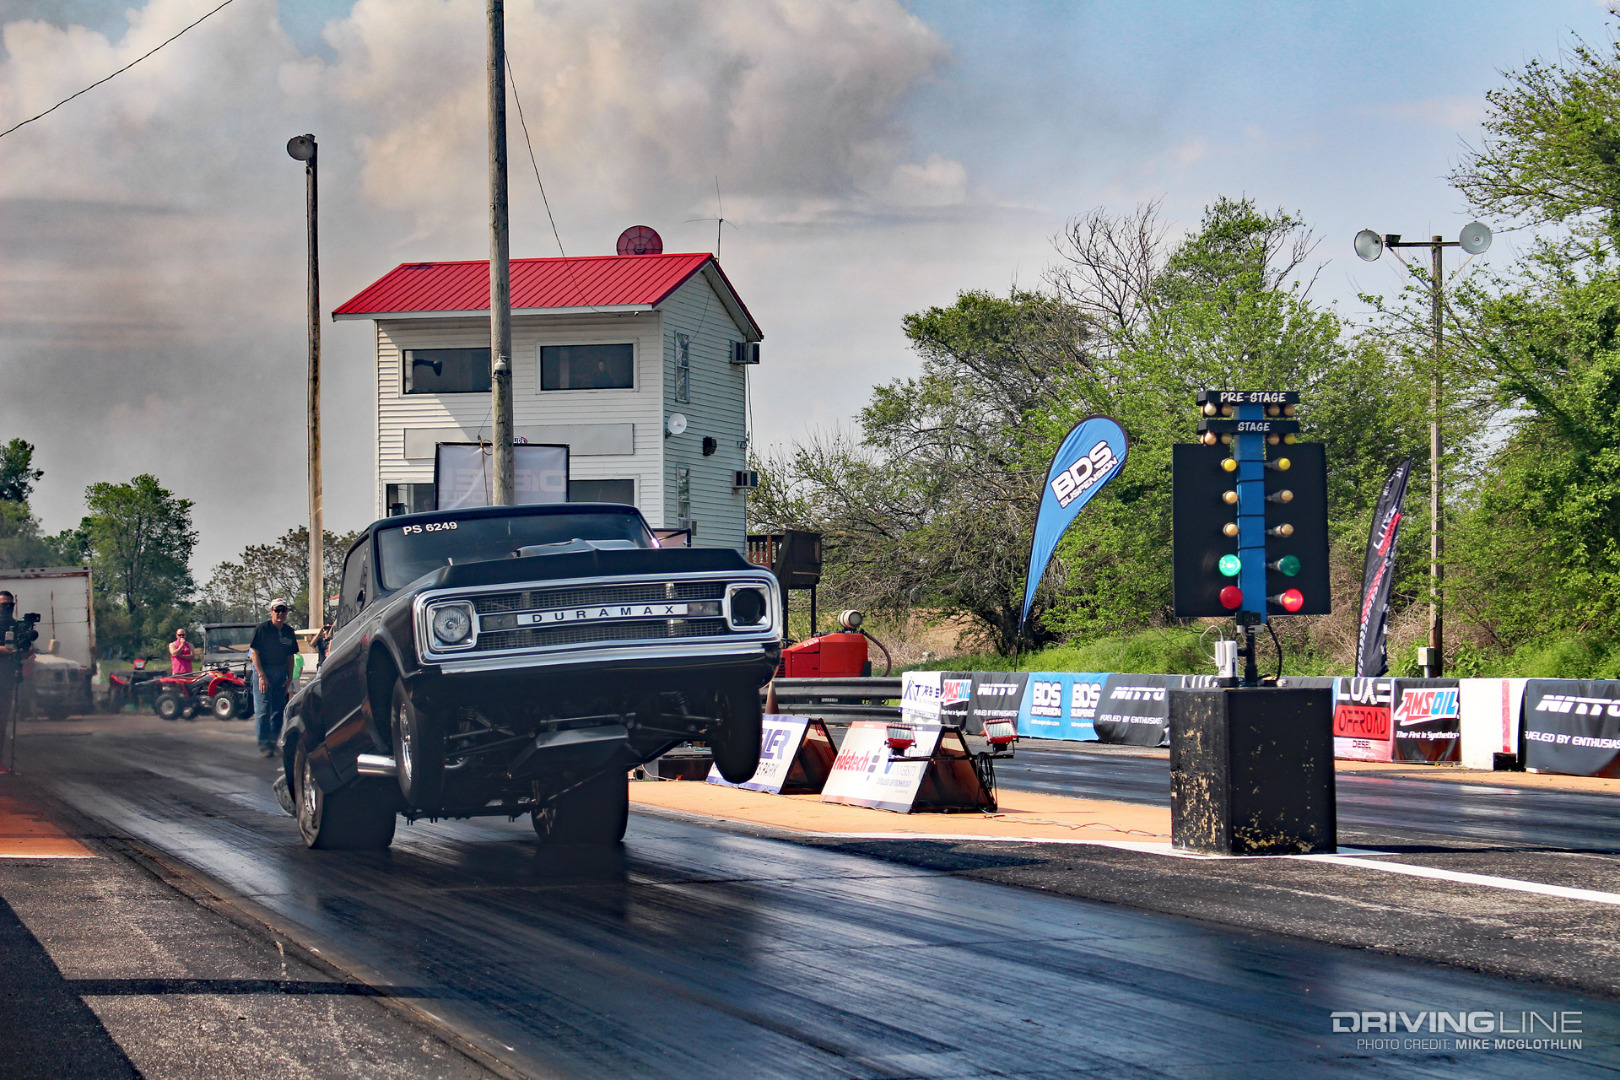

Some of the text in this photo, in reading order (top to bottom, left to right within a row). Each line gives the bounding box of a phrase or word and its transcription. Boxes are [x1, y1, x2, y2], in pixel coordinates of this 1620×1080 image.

[1219, 391, 1286, 404] PRE-STAGE
[1237, 421, 1271, 432] STAGE
[1050, 440, 1113, 500] BDS
[1059, 455, 1119, 509] SUSPENSION
[402, 520, 458, 537] PS 6249
[531, 604, 676, 623] DURAMAX
[1032, 681, 1062, 707] BDS
[1071, 682, 1102, 709] BDS
[1110, 686, 1166, 701] NITTO
[1534, 693, 1620, 718] NITTO
[1397, 690, 1458, 722] AMSOIL
[1338, 709, 1388, 735] OFFROAD
[1556, 733, 1572, 745] BY
[833, 749, 871, 772] ridetech
